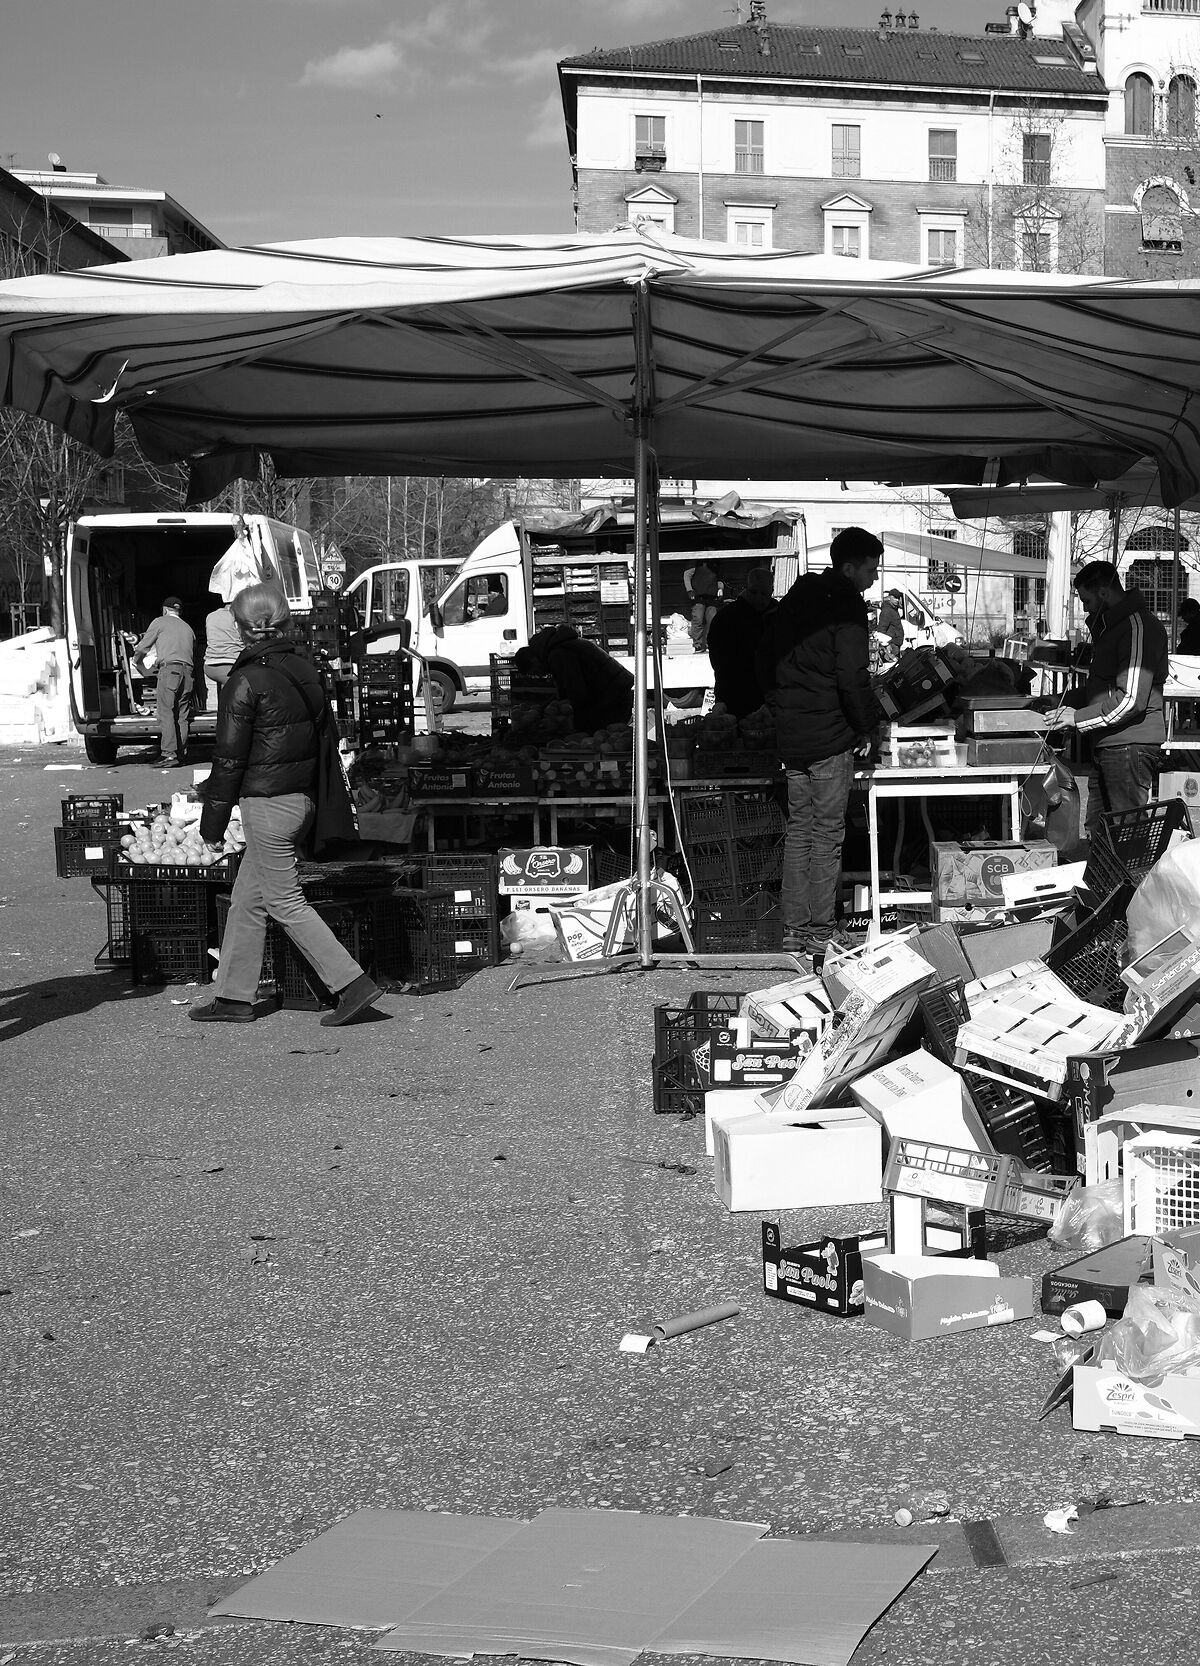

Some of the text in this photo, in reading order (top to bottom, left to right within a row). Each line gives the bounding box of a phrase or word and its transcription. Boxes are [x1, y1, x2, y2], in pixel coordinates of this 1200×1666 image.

[329, 576, 339, 585] 30
[421, 783, 454, 791] Antonio
[487, 781, 521, 789] Antonio
[987, 864, 1009, 874] SCB
[850, 911, 898, 927] Morna
[731, 1054, 804, 1071] San Paol
[777, 1258, 838, 1292] San Paolo
[1050, 1280, 1079, 1289] AVOCADOS
[1106, 1388, 1136, 1402] Zespri
